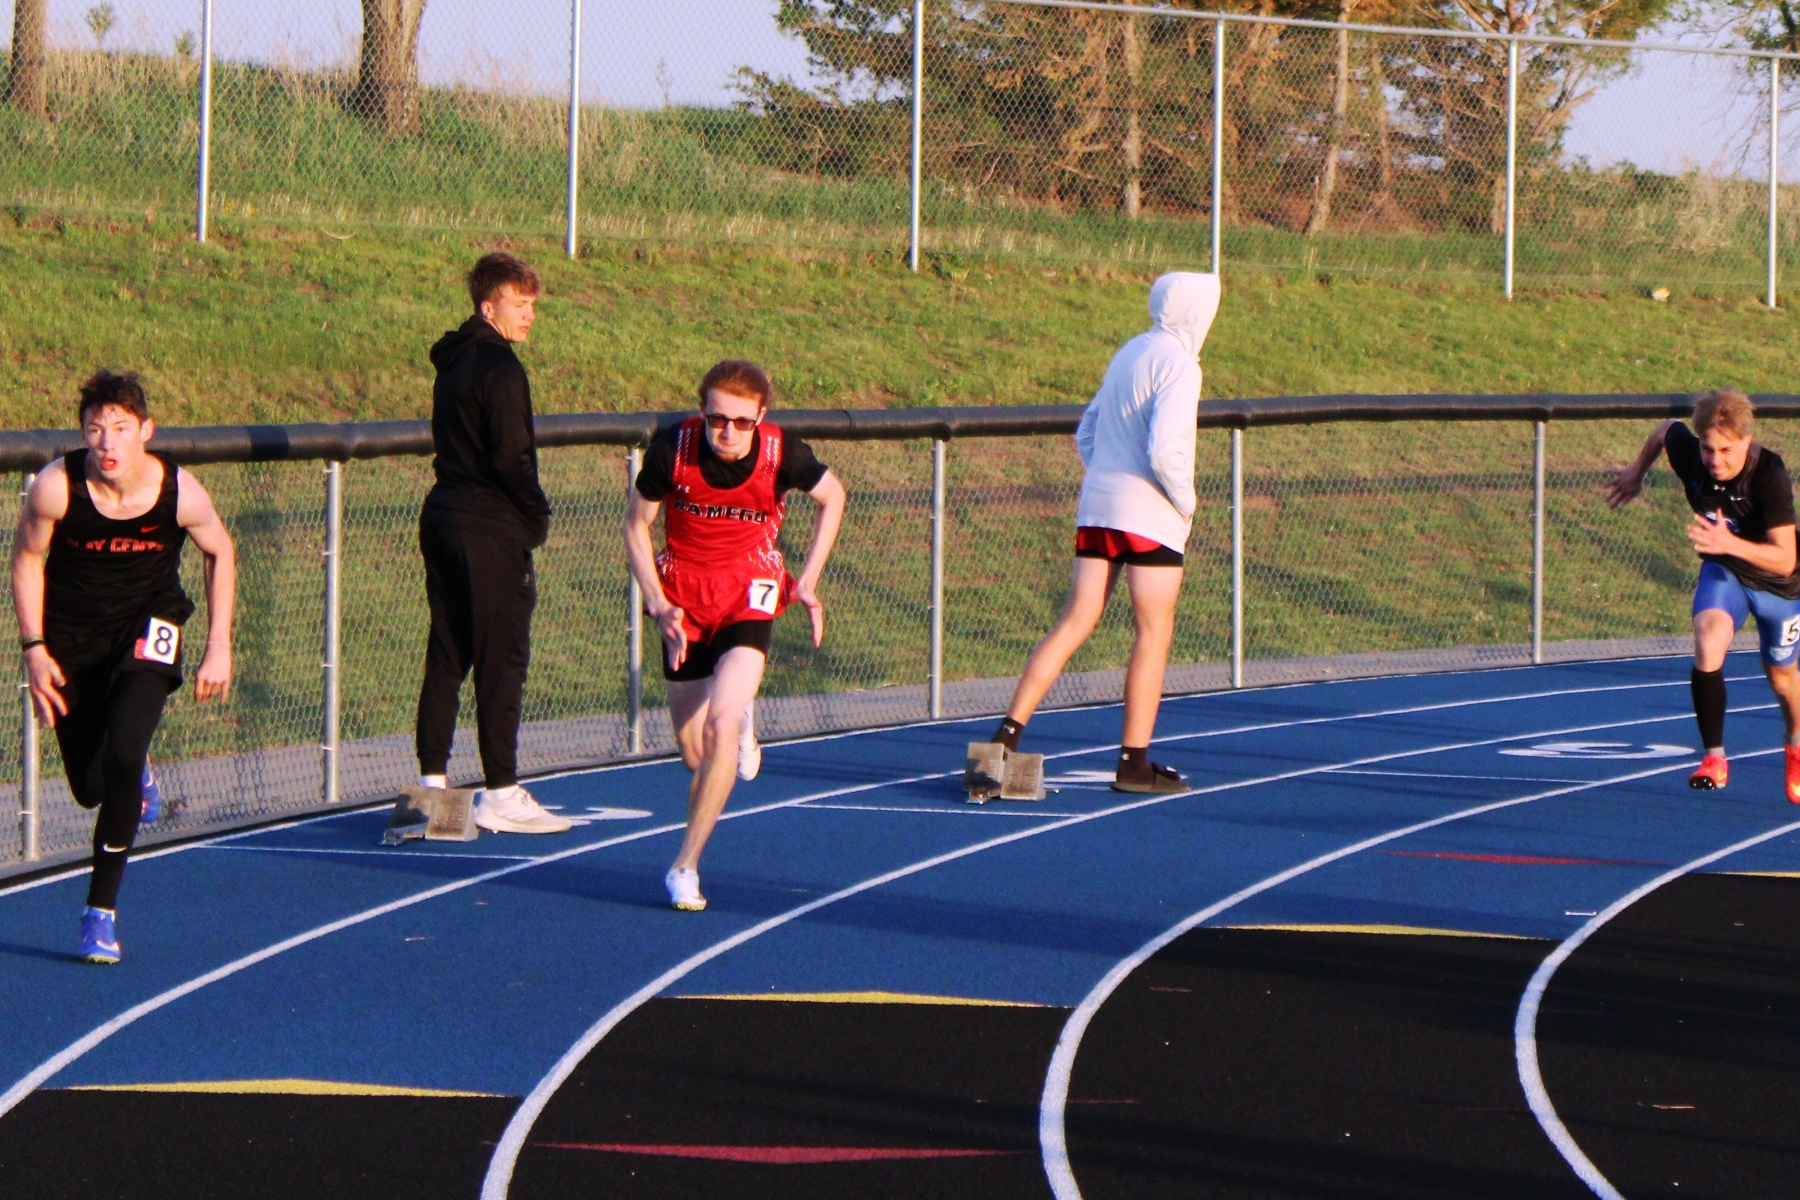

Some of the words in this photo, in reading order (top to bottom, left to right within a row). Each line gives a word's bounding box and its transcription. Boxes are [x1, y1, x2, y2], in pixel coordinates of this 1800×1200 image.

[757, 583, 775, 606] 7
[153, 626, 173, 657] 8
[1787, 618, 1800, 644] 5
